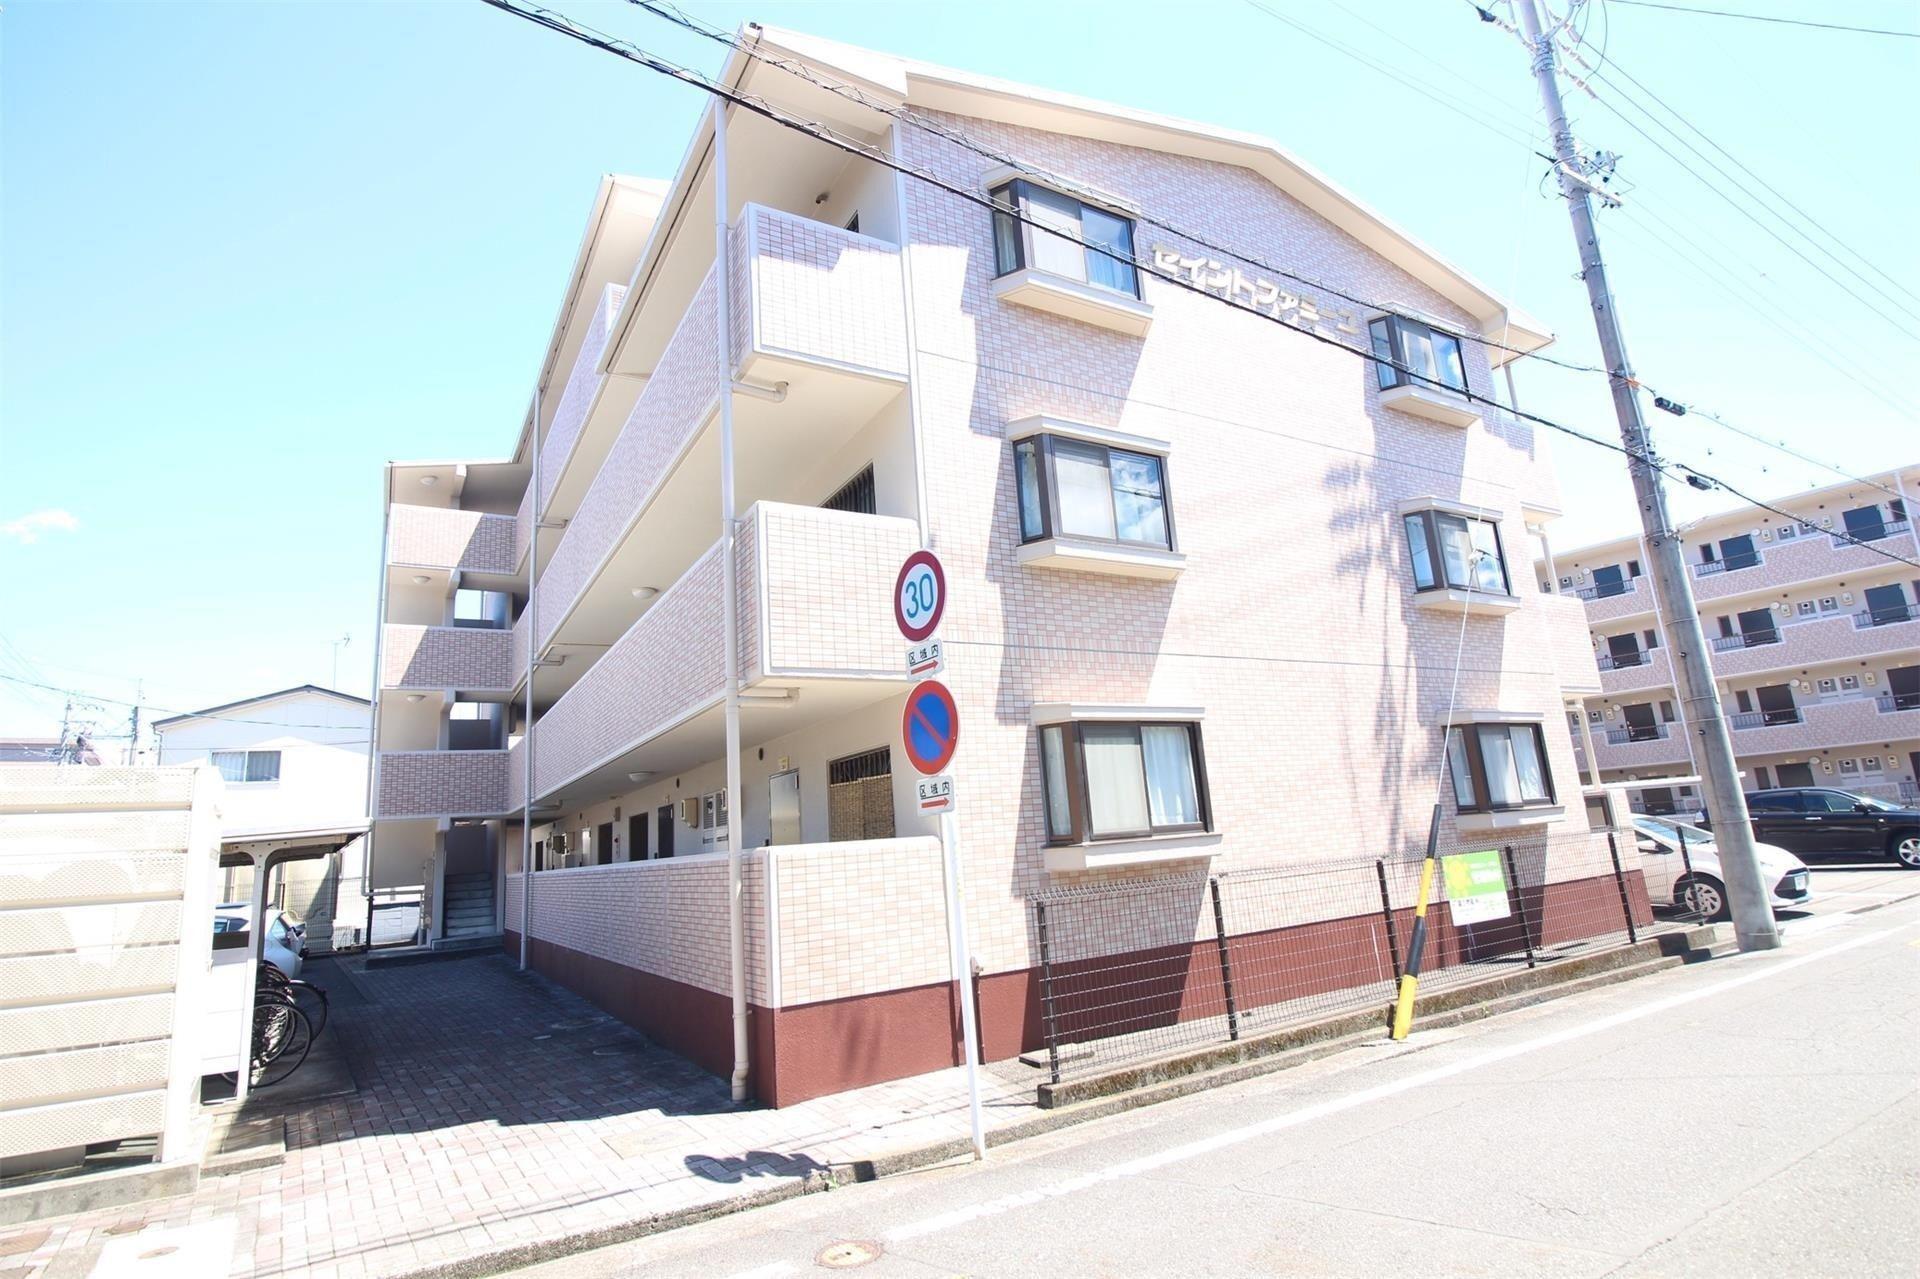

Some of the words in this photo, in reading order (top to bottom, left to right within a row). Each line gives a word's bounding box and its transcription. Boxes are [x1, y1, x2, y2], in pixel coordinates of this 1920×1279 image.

[905, 573, 934, 618] 30
[908, 644, 939, 666] 区域内
[919, 781, 950, 798] 区域内
